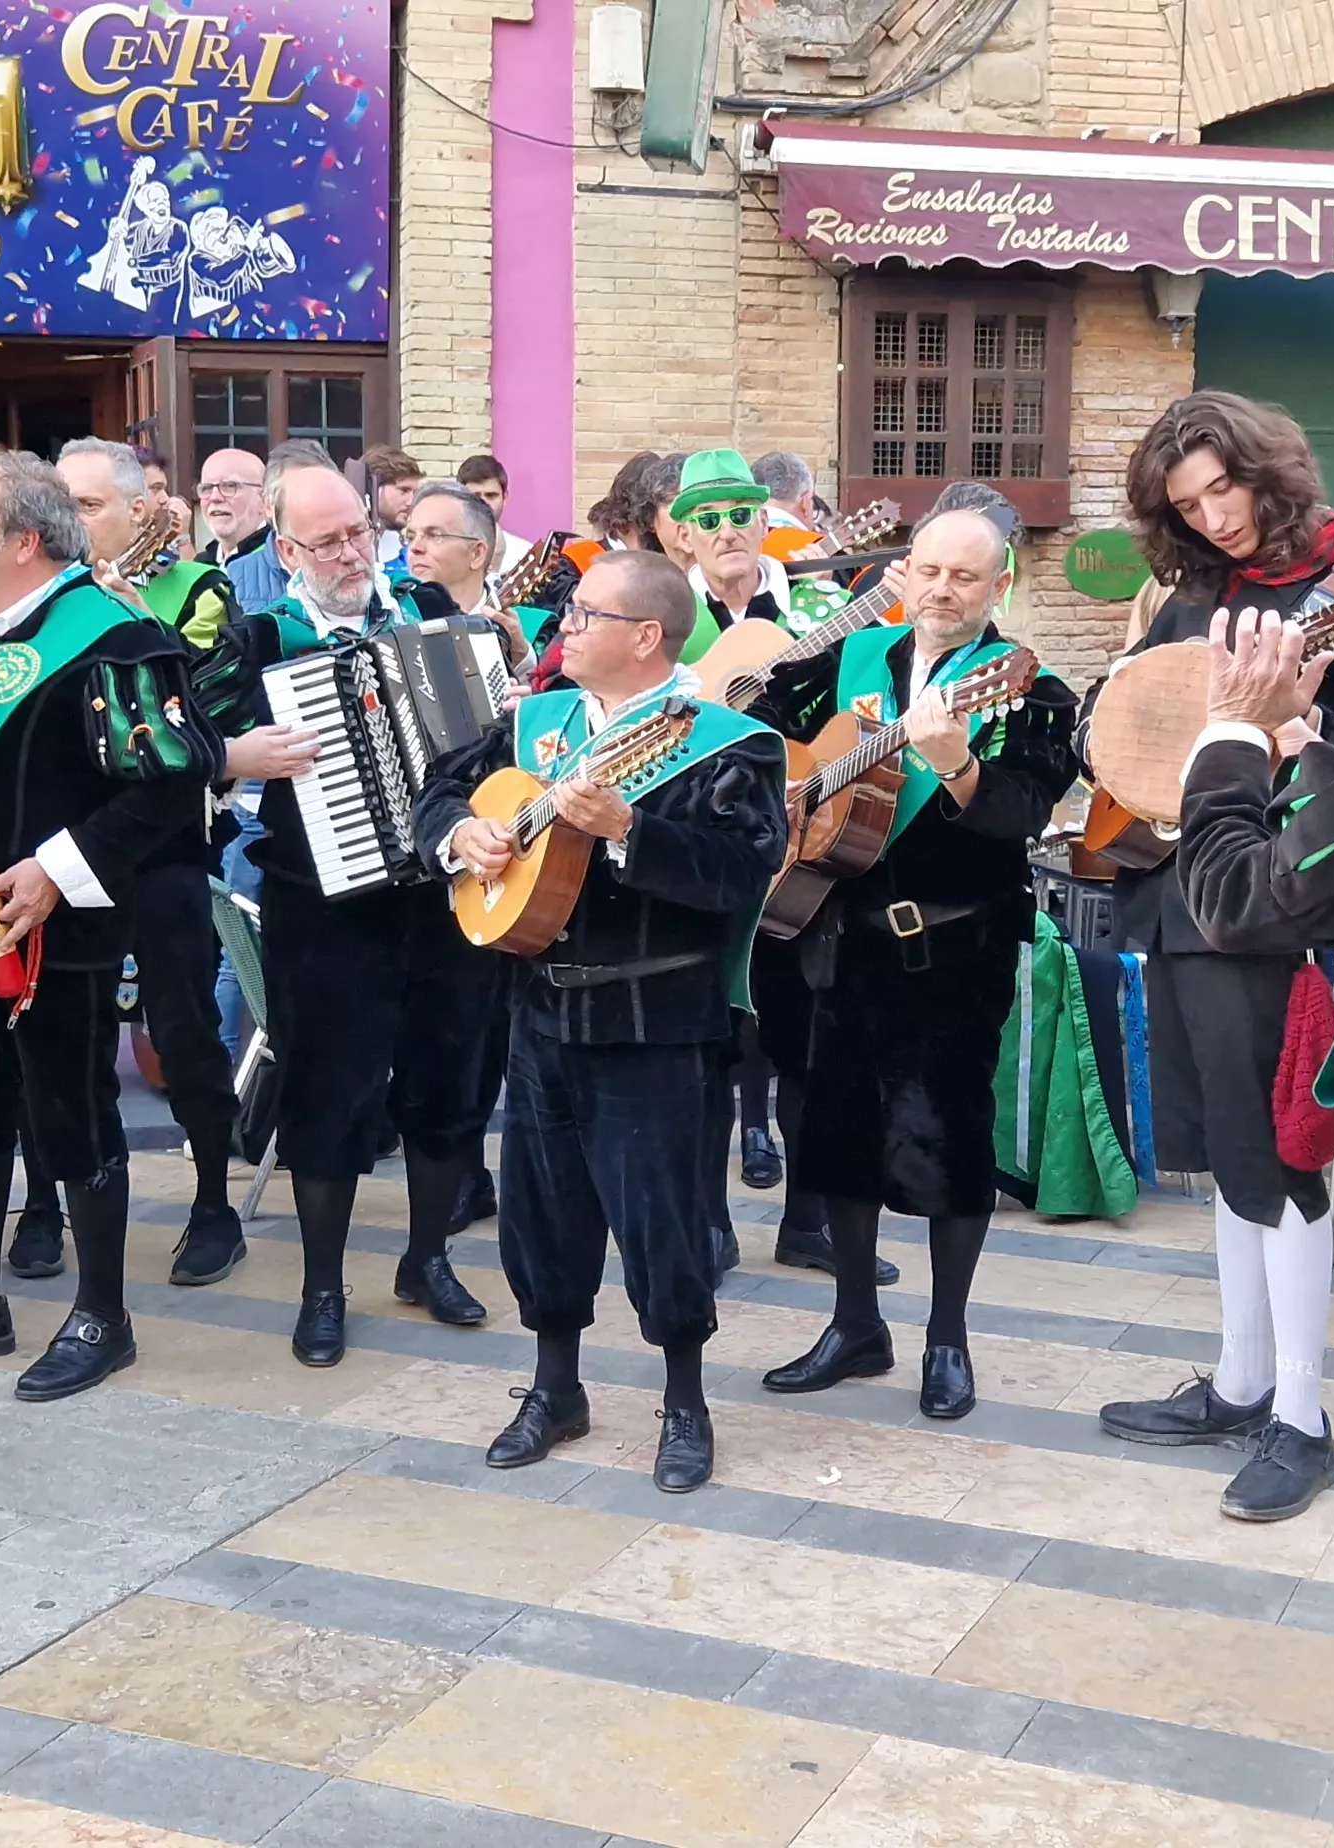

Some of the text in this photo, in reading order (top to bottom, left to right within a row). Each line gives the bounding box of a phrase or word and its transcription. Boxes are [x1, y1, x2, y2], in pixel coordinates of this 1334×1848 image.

[61, 3, 306, 103] CENTRAL
[116, 85, 254, 152] CAFÉ
[882, 172, 1055, 216] Ensaladas
[805, 206, 1131, 254] Raciones Tostadas
